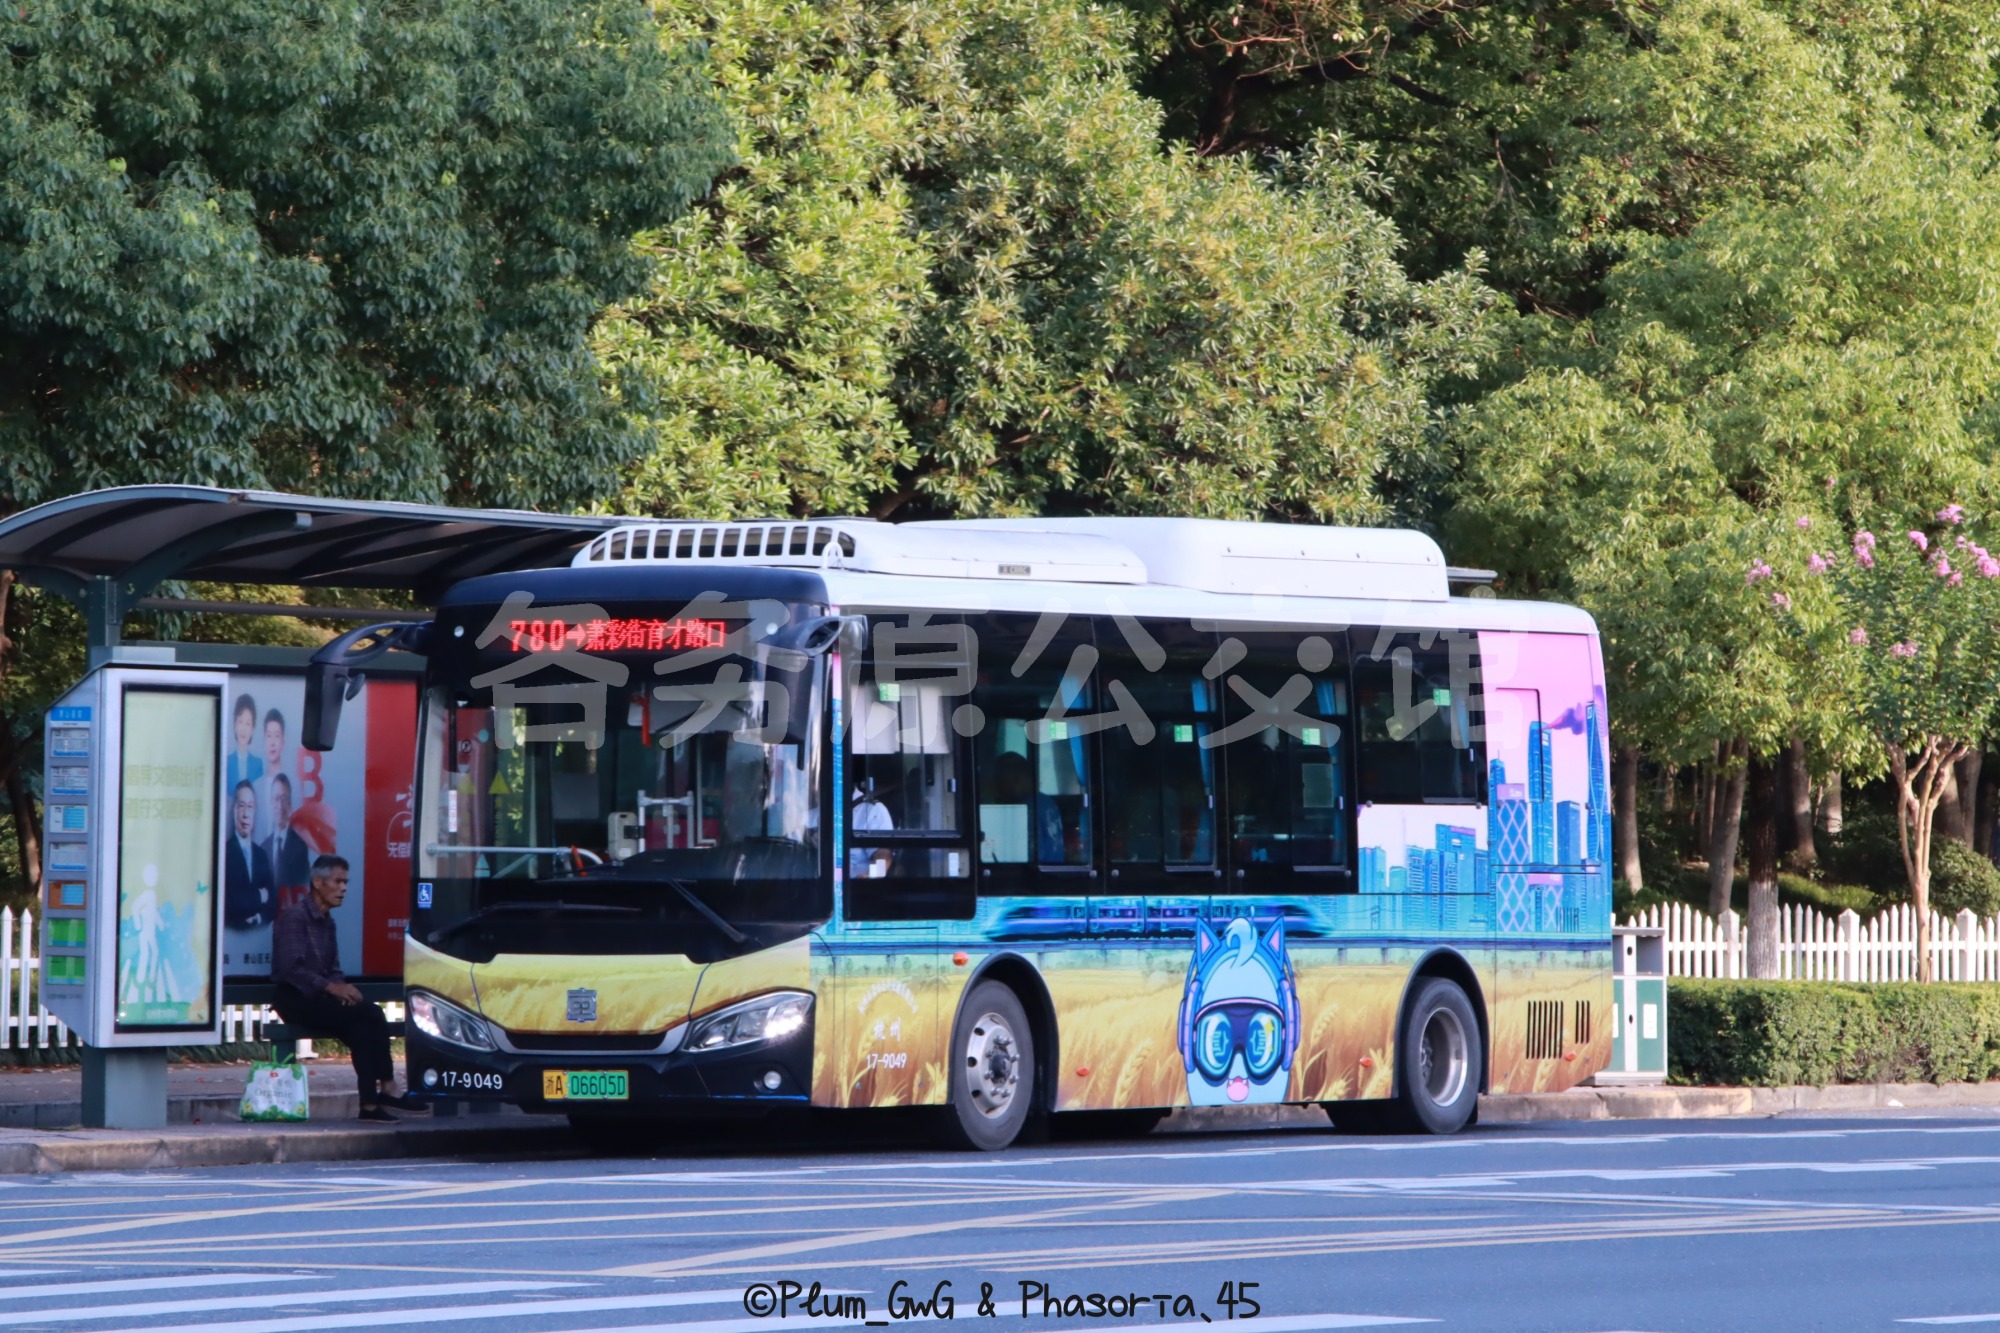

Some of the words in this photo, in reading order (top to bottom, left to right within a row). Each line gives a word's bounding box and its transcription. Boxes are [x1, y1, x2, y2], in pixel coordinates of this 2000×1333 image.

[510, 620, 566, 651] 780
[584, 618, 726, 650] 萧彩街育才路口
[866, 1052, 908, 1069] 17-9049
[441, 1071, 503, 1090] 17-9049
